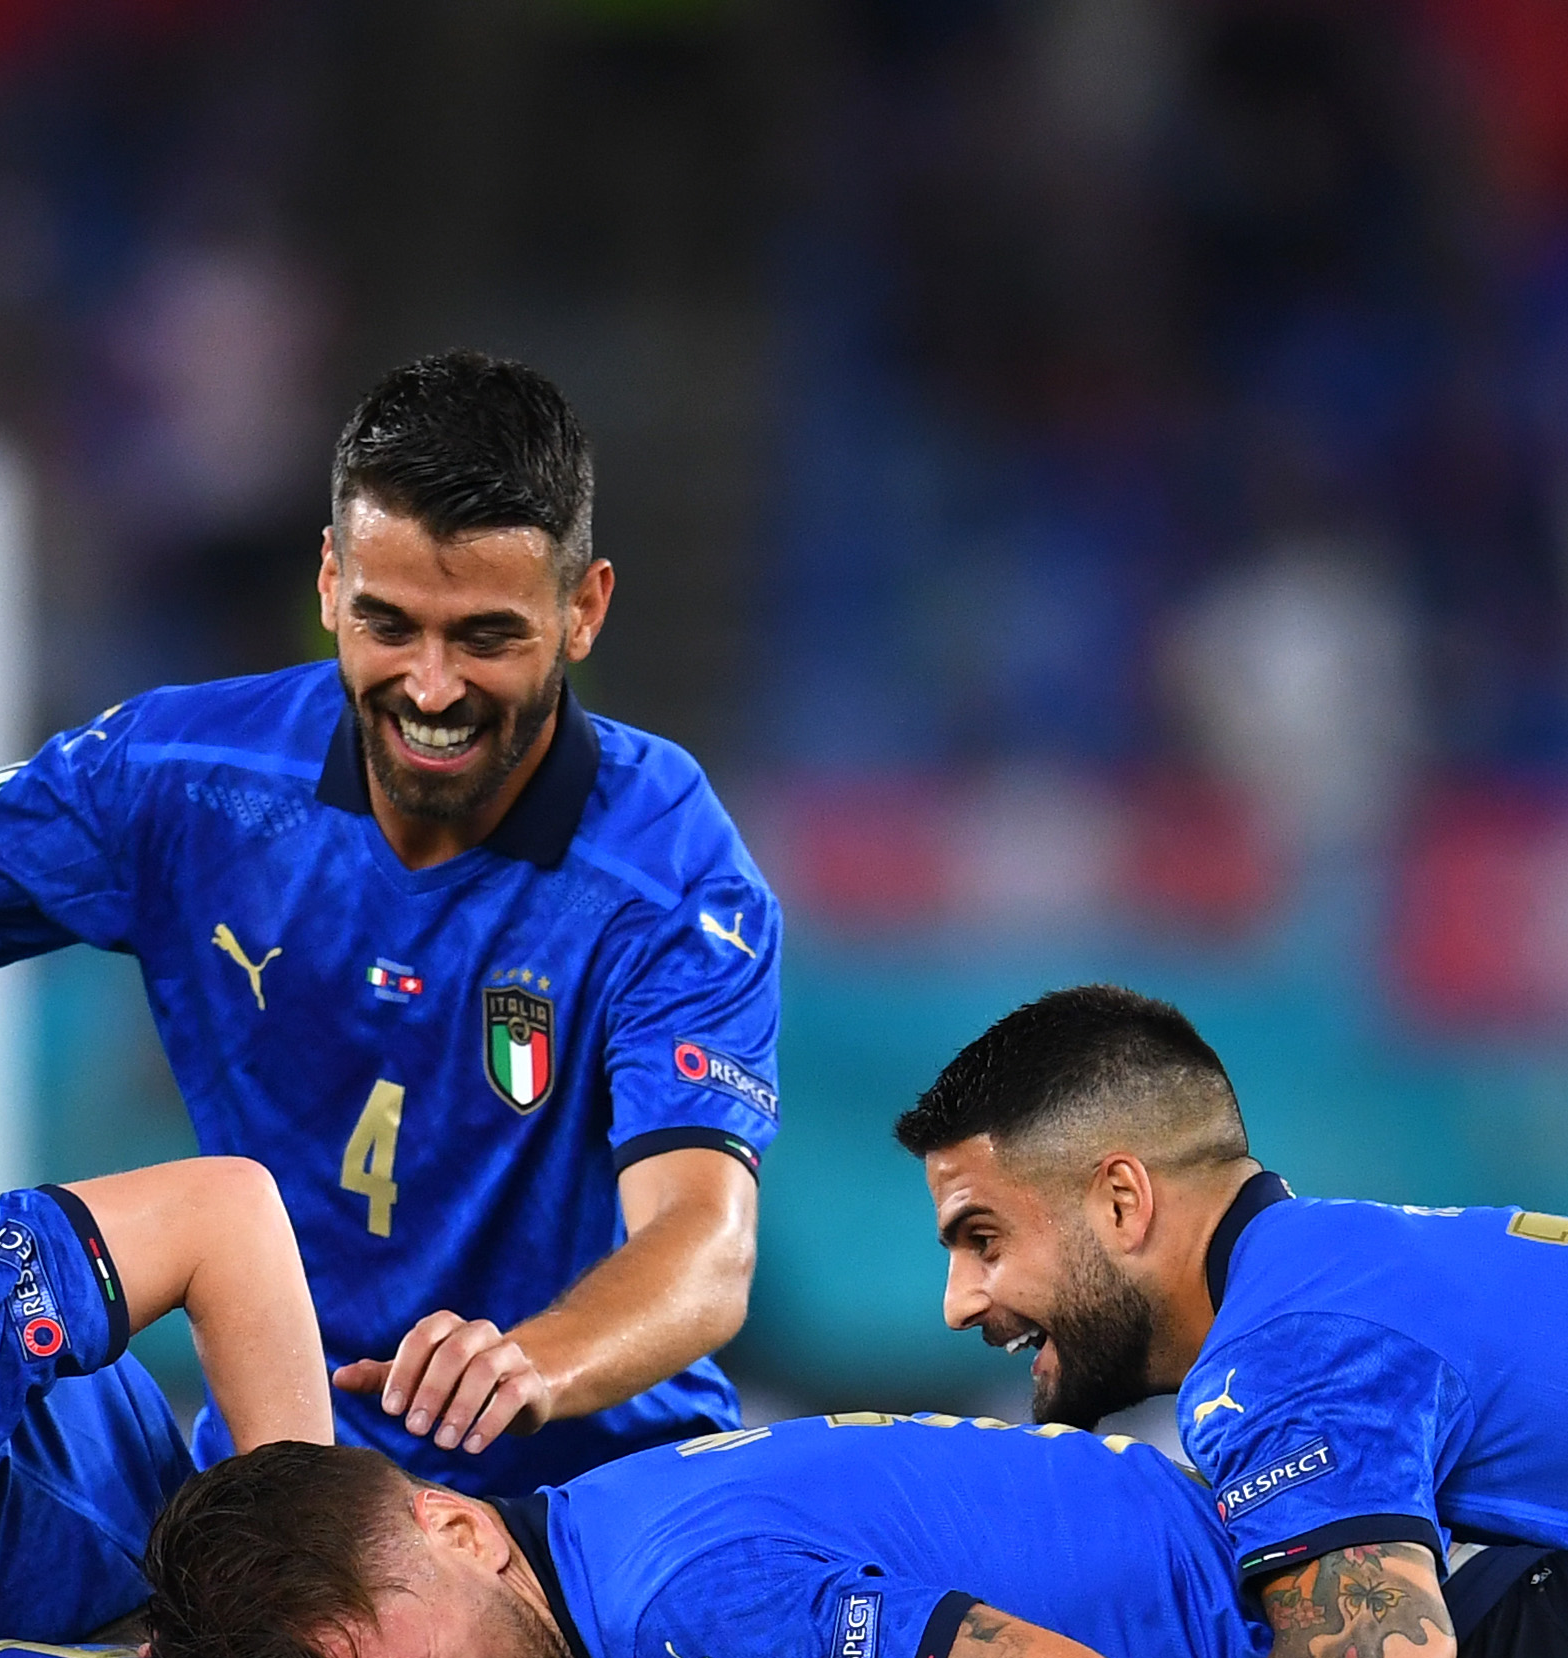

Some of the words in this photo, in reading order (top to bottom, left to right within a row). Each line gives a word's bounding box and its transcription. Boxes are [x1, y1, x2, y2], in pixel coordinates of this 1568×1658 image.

[490, 996, 547, 1023] ITALIA
[339, 1079, 406, 1239] 4
[1226, 1446, 1330, 1508] RESPECT
